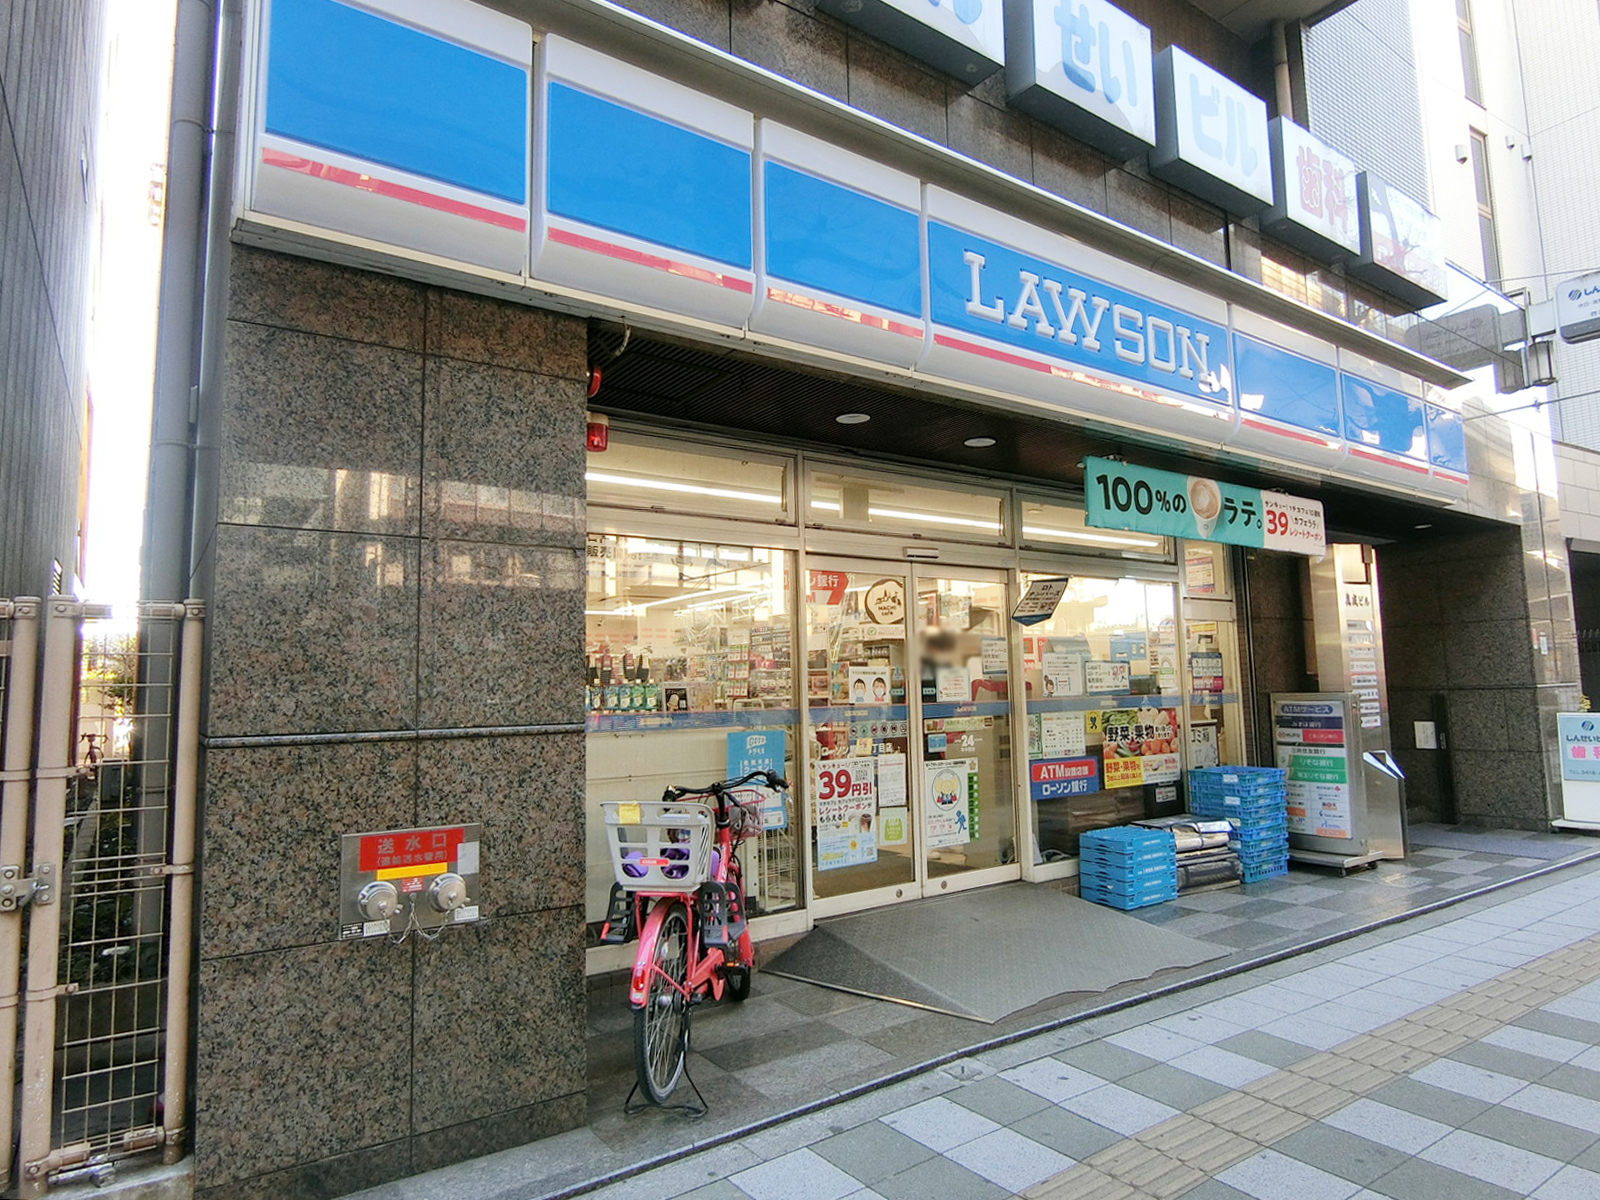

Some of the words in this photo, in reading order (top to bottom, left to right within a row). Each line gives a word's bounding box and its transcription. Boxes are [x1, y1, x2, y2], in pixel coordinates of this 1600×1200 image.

[1054, 0, 1137, 107] せい
[1189, 73, 1259, 177] ビル
[1296, 145, 1348, 235] 歯科
[963, 249, 1215, 386] LAWSON
[1096, 474, 1187, 515] 100%の
[1224, 497, 1263, 529] ラテ。
[1266, 510, 1288, 535] 39
[961, 734, 975, 747] 24
[1107, 724, 1155, 742] 野菜・果物
[1042, 780, 1088, 796] ローソン銀行
[378, 833, 447, 854] 送水口
